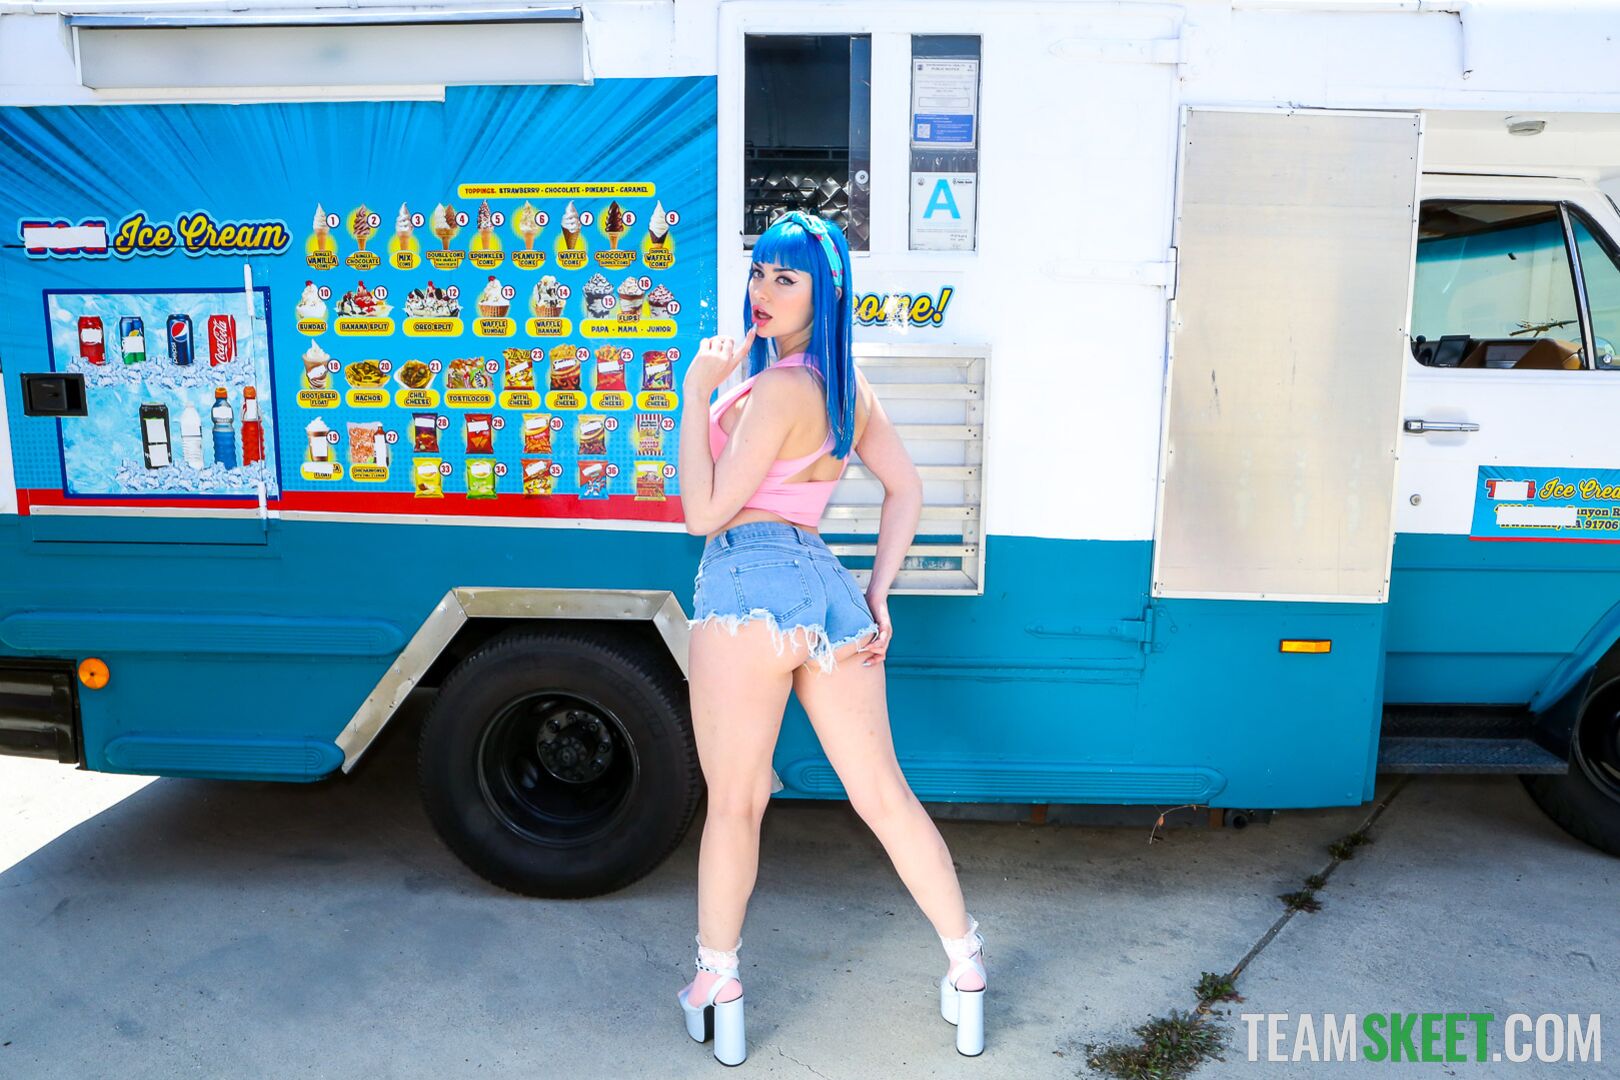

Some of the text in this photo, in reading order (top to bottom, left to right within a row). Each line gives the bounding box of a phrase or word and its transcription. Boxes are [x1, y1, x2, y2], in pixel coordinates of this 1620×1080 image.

[923, 179, 960, 219] A
[330, 216, 334, 224] 1
[372, 216, 376, 224] 2
[414, 216, 420, 226] 3
[460, 214, 466, 224] 4
[496, 214, 500, 224] 5
[540, 214, 546, 224] 6
[584, 214, 590, 224] 7
[626, 214, 632, 224] 8
[670, 214, 676, 224] 9
[115, 215, 174, 252] Ice
[179, 214, 287, 249] Cream
[640, 280, 650, 288] 16
[320, 288, 328, 298] 10
[378, 288, 384, 296] 11
[450, 288, 456, 296] 12
[504, 288, 514, 296] 13
[560, 288, 568, 296] 14
[604, 298, 614, 306] 15
[670, 304, 678, 312] 17
[532, 350, 542, 358] 23
[578, 350, 588, 358] 24
[622, 352, 632, 360] 25
[668, 350, 678, 358] 26
[330, 362, 338, 370] 18
[380, 362, 390, 370] 20
[430, 362, 438, 370] 21
[488, 362, 498, 370] 22
[438, 418, 446, 426] 28
[494, 418, 502, 428] 29
[552, 420, 562, 428] 30
[608, 420, 616, 428] 31
[664, 420, 672, 428] 32
[328, 434, 338, 442] 19
[388, 434, 396, 442] 27
[442, 464, 450, 474] 33
[496, 466, 506, 474] 34
[552, 466, 560, 474] 35
[608, 466, 616, 474] 36
[666, 468, 674, 476] 37
[1540, 479, 1574, 499] Ice
[1585, 520, 1618, 529] 91706
